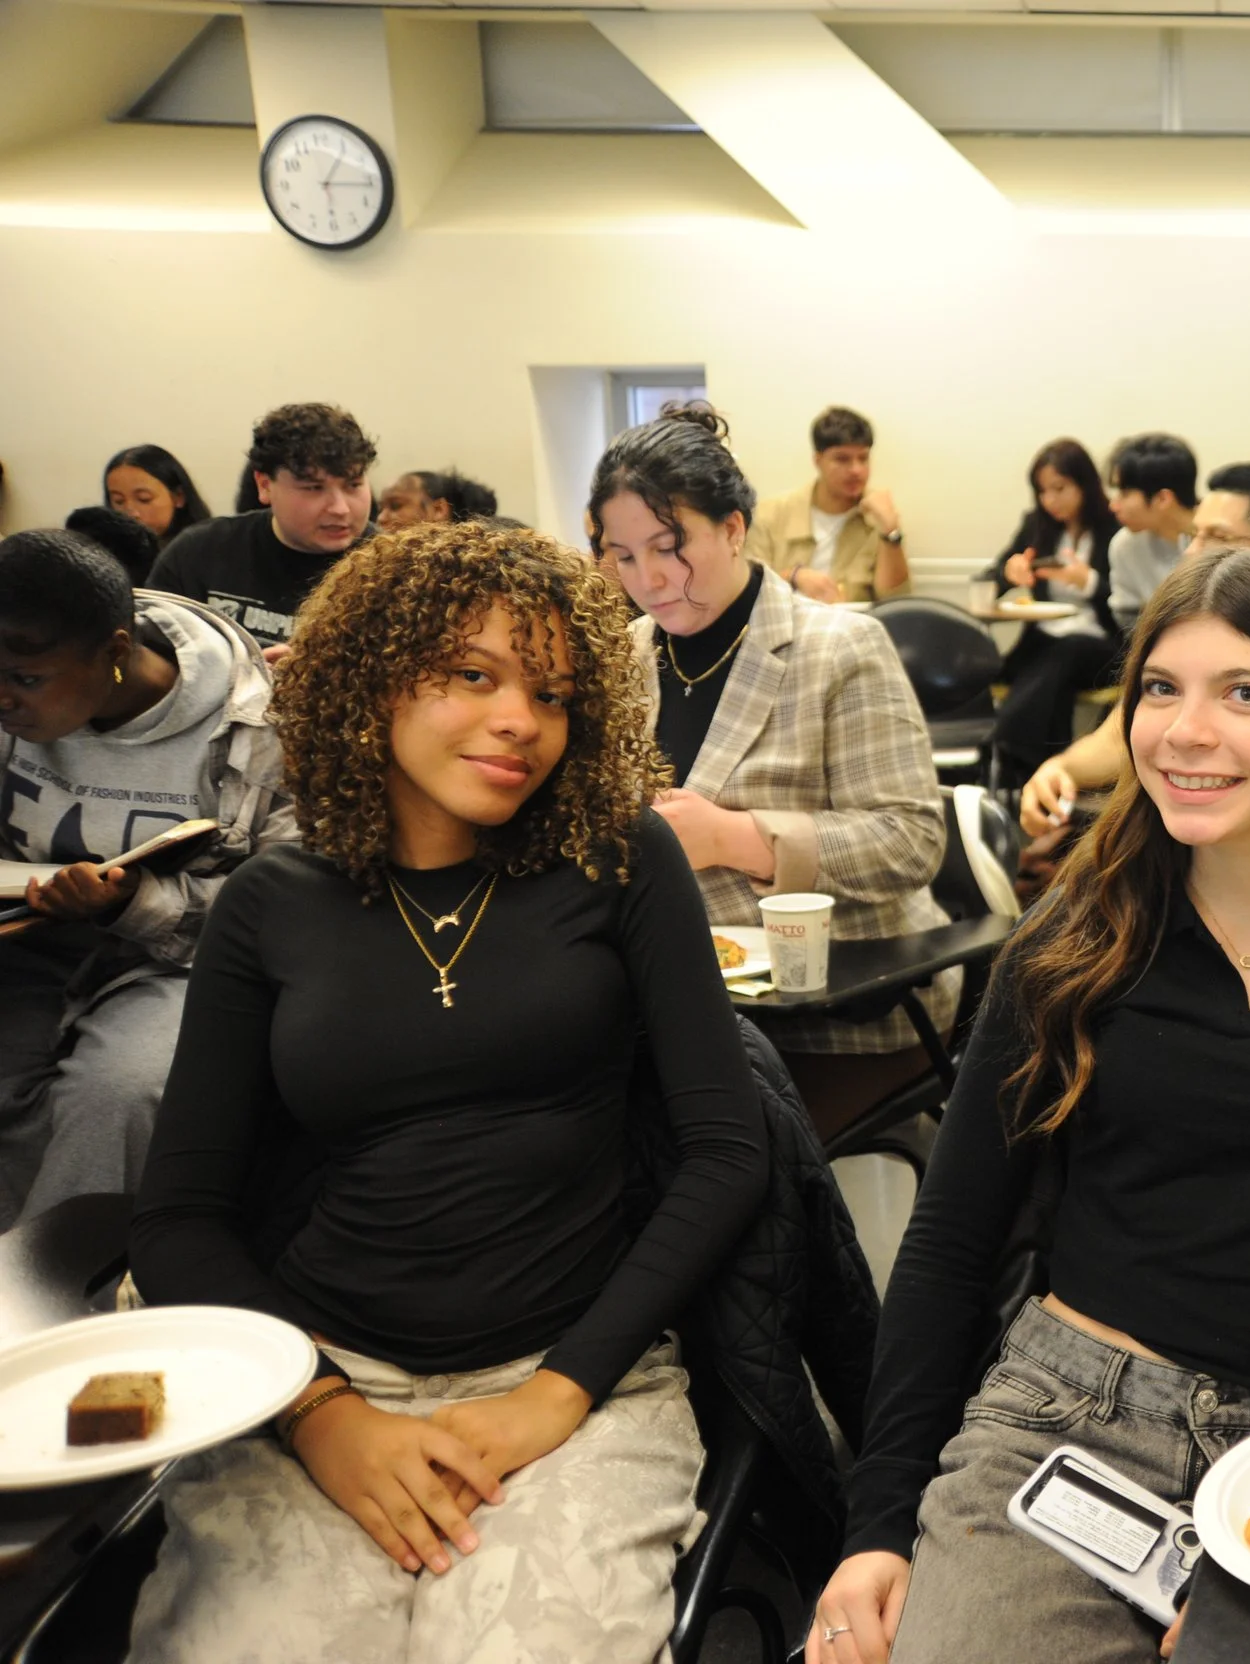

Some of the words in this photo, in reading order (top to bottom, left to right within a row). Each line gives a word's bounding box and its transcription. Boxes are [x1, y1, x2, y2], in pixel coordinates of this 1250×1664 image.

[284, 159, 301, 173] 10
[36, 766, 73, 793] SCHOOL
[75, 785, 90, 797] OF
[90, 786, 131, 801] FASHION
[133, 790, 188, 806] INDUSTRIES
[189, 794, 200, 806] IS
[766, 923, 806, 935] MATTO
